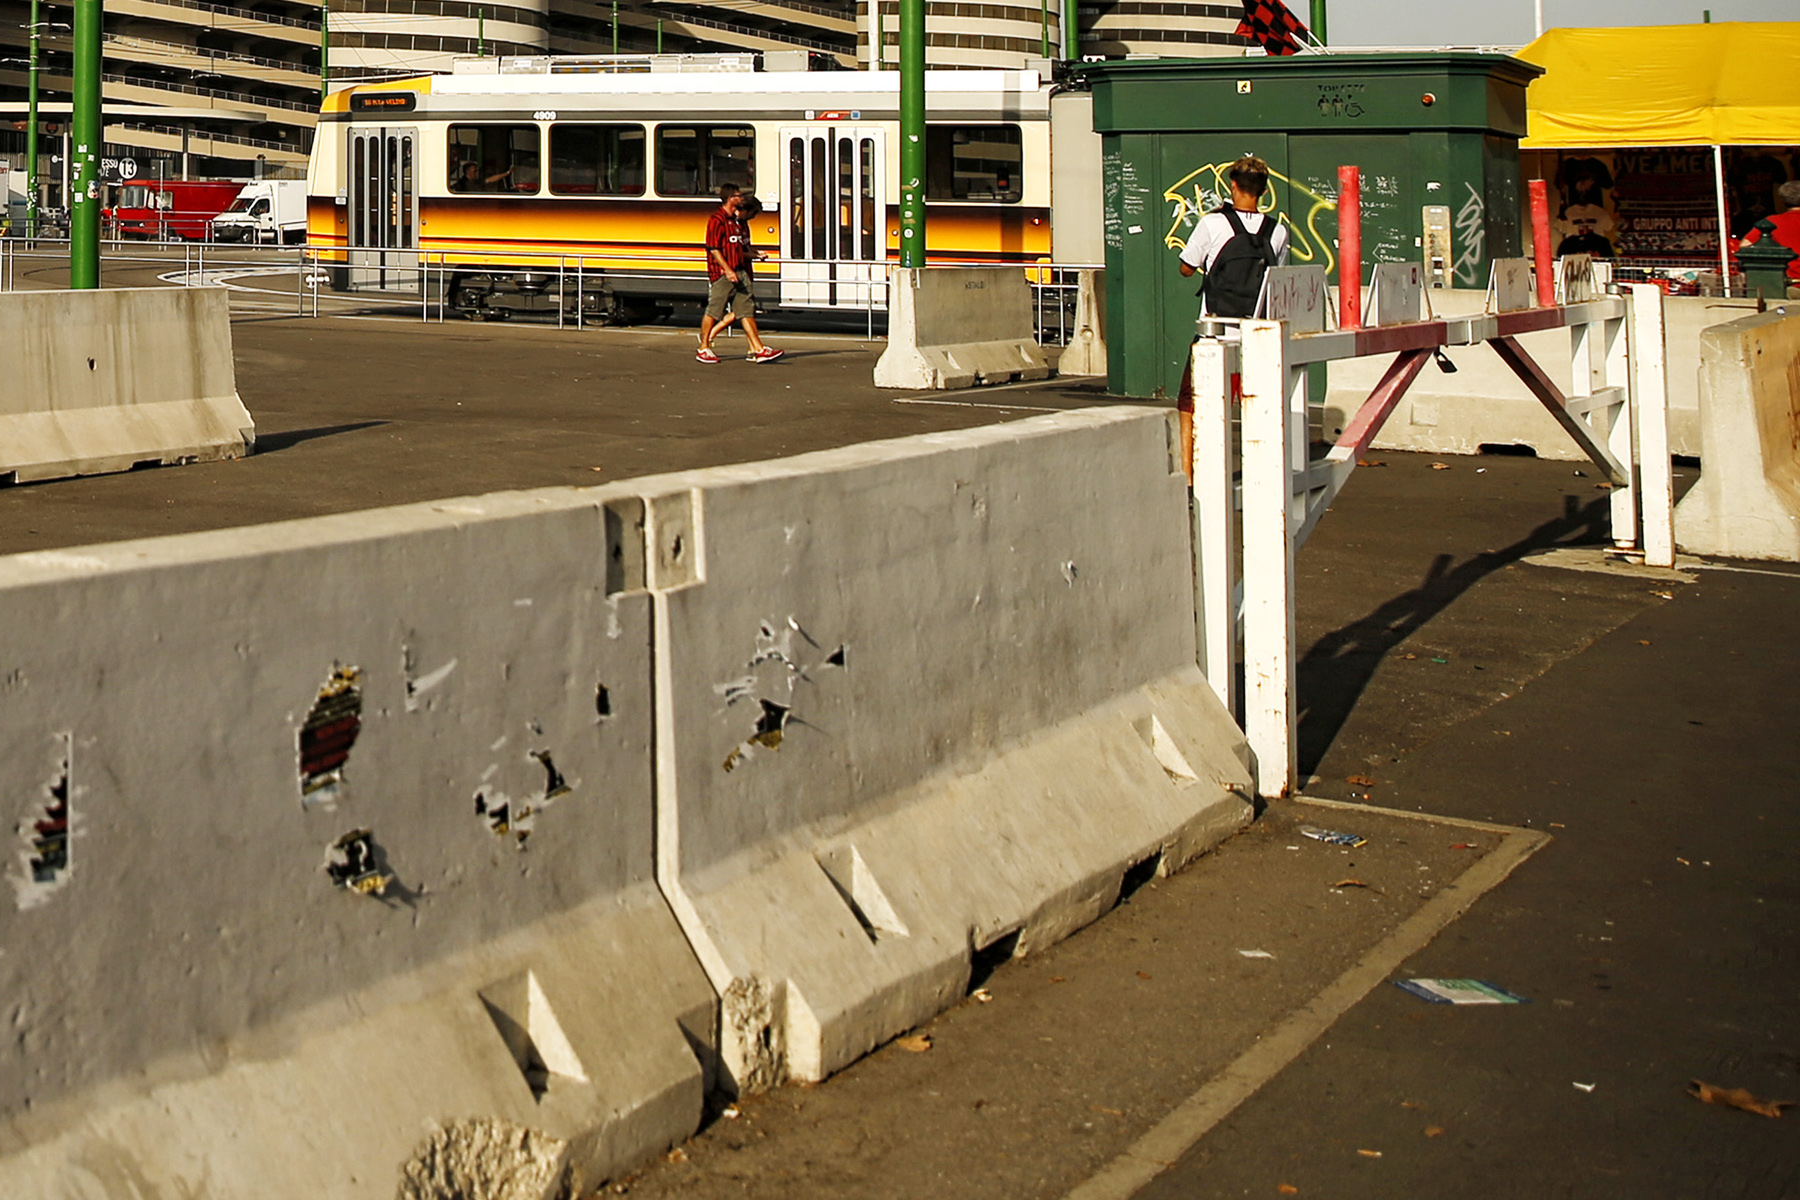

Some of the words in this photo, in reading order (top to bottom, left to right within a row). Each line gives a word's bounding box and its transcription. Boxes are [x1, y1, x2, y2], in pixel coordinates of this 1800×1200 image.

[533, 110, 556, 120] 4909
[121, 160, 134, 176] 13
[1633, 217, 1673, 230] GRUPPO
[1674, 217, 1699, 230] ANTI
[1701, 217, 1718, 230] INT
